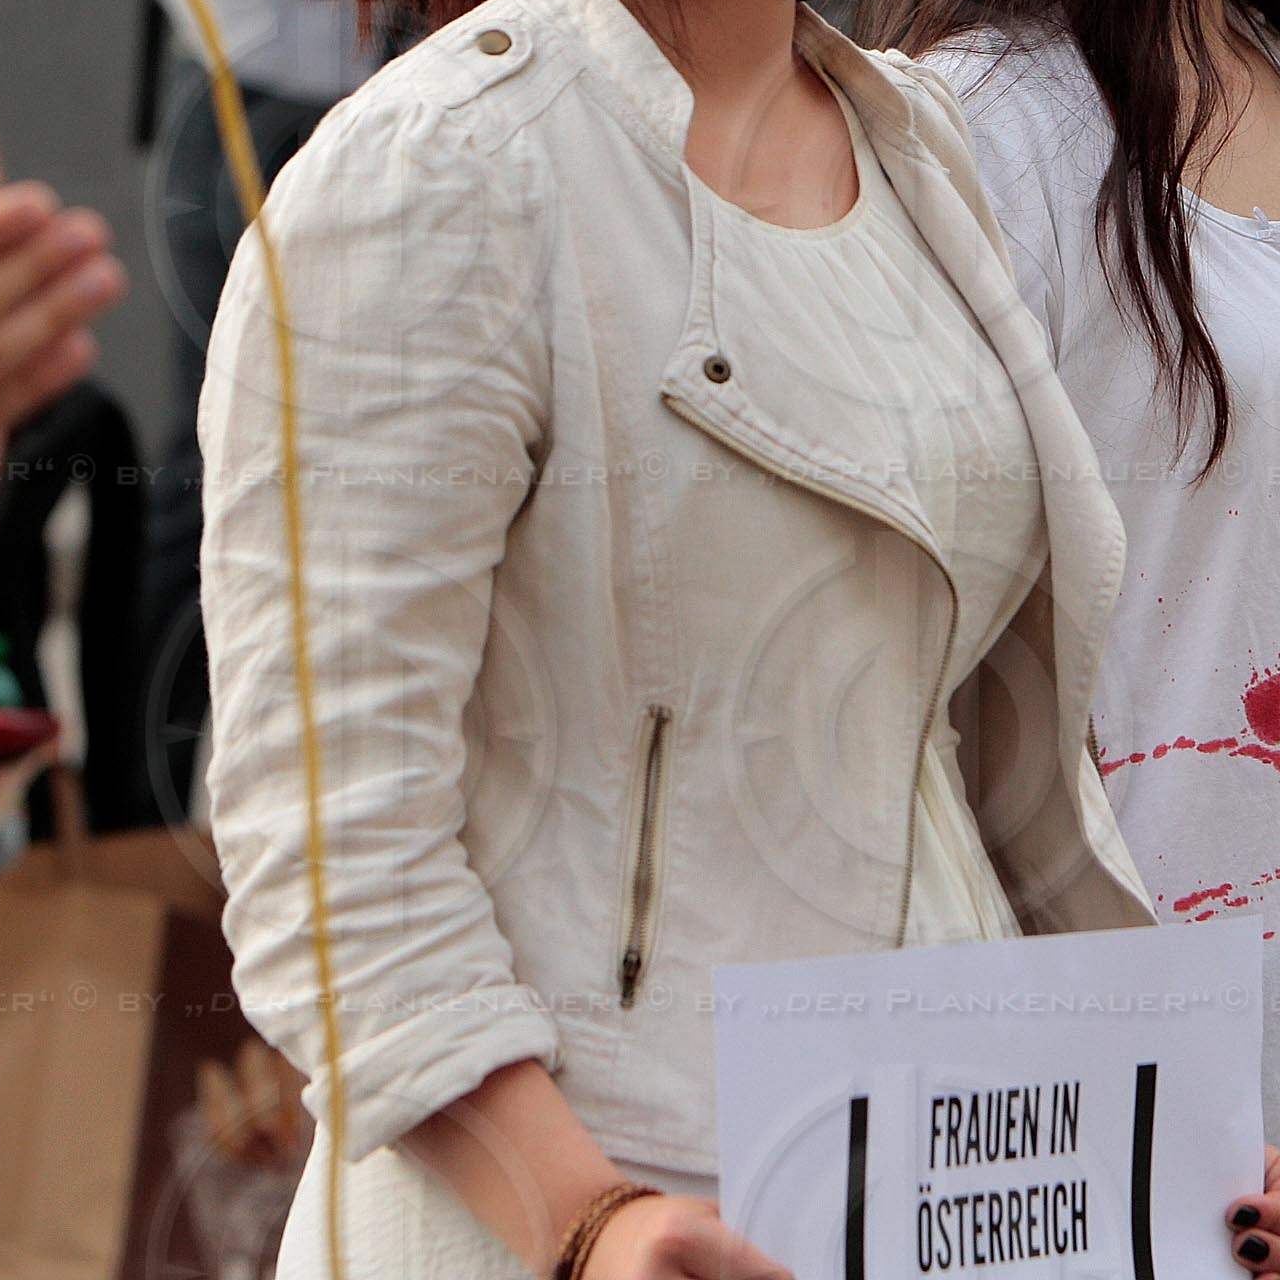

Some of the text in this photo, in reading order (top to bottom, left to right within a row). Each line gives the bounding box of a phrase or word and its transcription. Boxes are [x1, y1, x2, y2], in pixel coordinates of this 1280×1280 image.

[929, 1081, 1080, 1169] FRAUEN IN
[918, 1178, 1088, 1272] ÖSTERREICH
